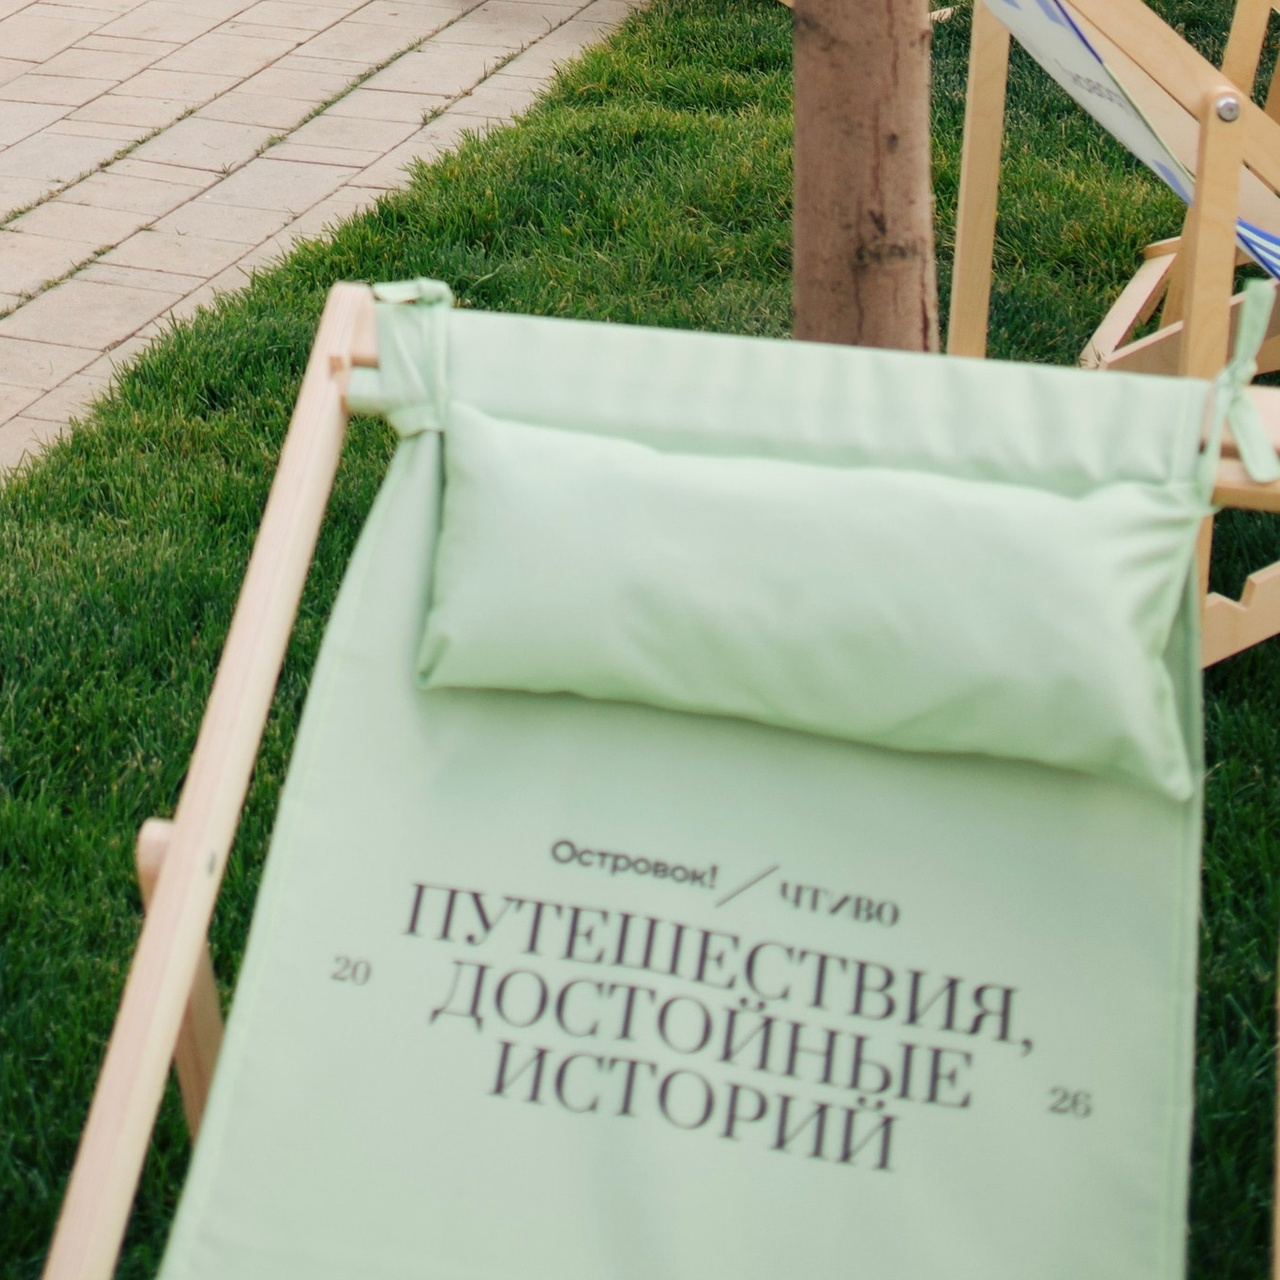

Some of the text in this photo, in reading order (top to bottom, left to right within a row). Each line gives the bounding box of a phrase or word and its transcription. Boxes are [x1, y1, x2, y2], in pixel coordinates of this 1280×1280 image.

[549, 838, 901, 930] Островок! ЧТИВО
[330, 955, 373, 987] 20
[402, 881, 1034, 1057] ПУТЕШЕСТВИЯ,
[429, 958, 977, 1111] ДОСТОЙНЫЕ
[486, 1040, 901, 1173] ИСТОРИЙ
[1048, 1084, 1094, 1120] 26
